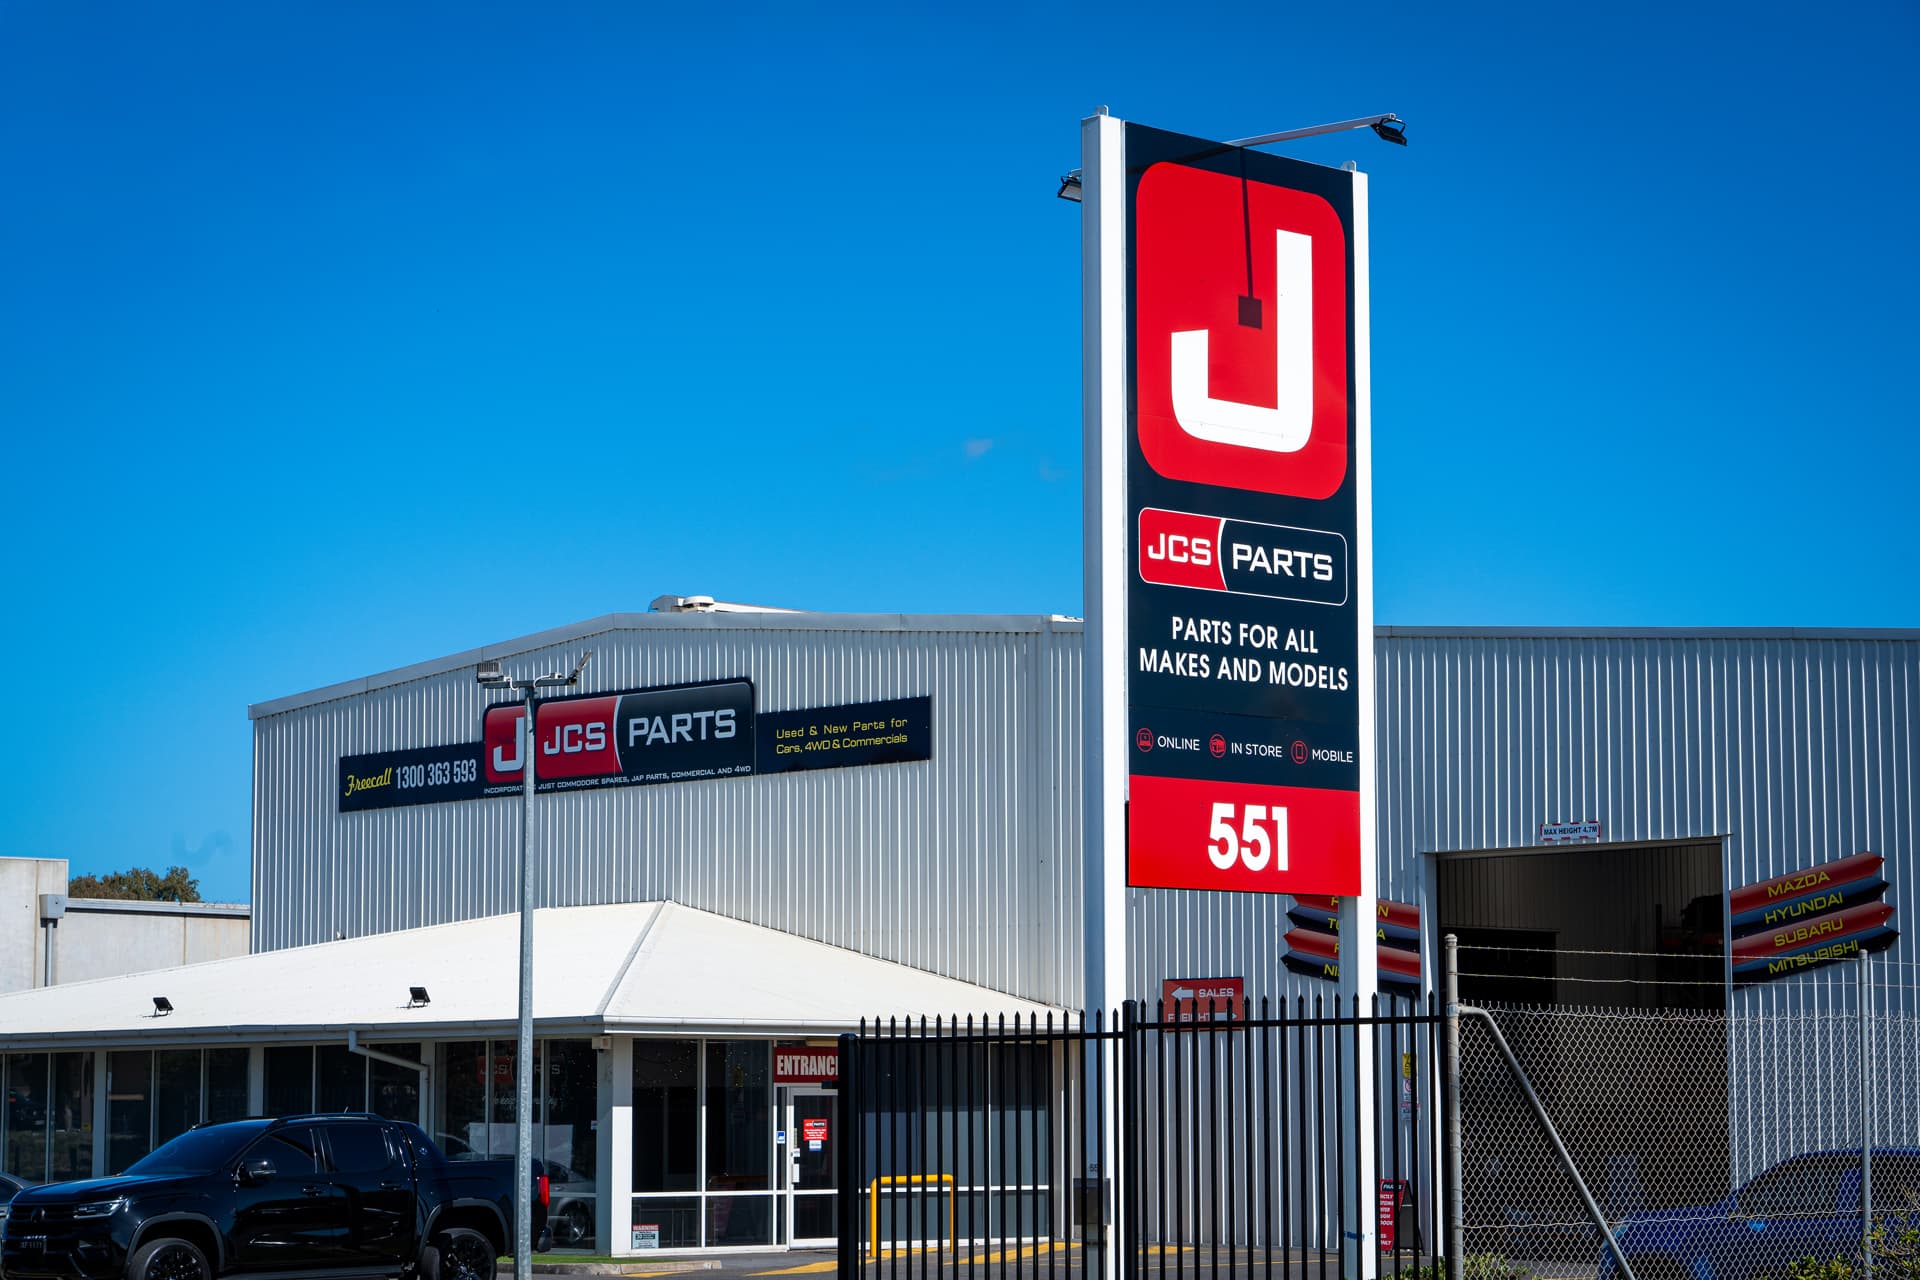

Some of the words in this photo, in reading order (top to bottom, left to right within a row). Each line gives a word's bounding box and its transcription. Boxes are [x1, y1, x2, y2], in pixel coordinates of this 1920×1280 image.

[1171, 229, 1313, 453] J
[1147, 533, 1212, 566] JCS
[1232, 543, 1333, 581] PARTS
[1172, 616, 1232, 646] PARTS
[1240, 623, 1278, 650] FOR
[1285, 628, 1318, 654] ALL
[1140, 648, 1210, 678] MAKES
[1217, 656, 1261, 682] AND
[1269, 660, 1349, 691] MODELS
[543, 722, 606, 755] JCS
[628, 709, 736, 747] PARTS
[776, 727, 804, 739] Used
[809, 726, 818, 736] &
[824, 724, 848, 734] New
[853, 720, 885, 731] Parts
[891, 718, 908, 728] for
[776, 743, 802, 755] Cars,
[804, 740, 830, 751] 4WD
[832, 738, 840, 749] &
[842, 734, 908, 748] Commercials
[1157, 735, 1200, 751] ONLINE
[1231, 742, 1243, 754] IN
[1245, 743, 1283, 758] STORE
[1312, 749, 1353, 763] MOBILE
[344, 768, 392, 796] Freecall
[396, 764, 424, 790] 1300
[427, 761, 450, 786] 363
[453, 759, 477, 784] 593
[538, 782, 555, 790] JUST
[557, 778, 599, 788] COMMODORE
[602, 776, 629, 784] SPARES,
[632, 774, 644, 782] JAP
[646, 772, 669, 780] PARTS,
[672, 768, 715, 778] COMMERCIAL
[1208, 802, 1288, 871] 551
[1559, 826, 1581, 834] HEIGHT
[1767, 870, 1830, 898] MAZDA
[1764, 892, 1844, 924] HYUNDAI
[1774, 918, 1844, 948] SUBARU
[1768, 940, 1858, 975] MITSUBISHI
[1198, 988, 1234, 998] SALES
